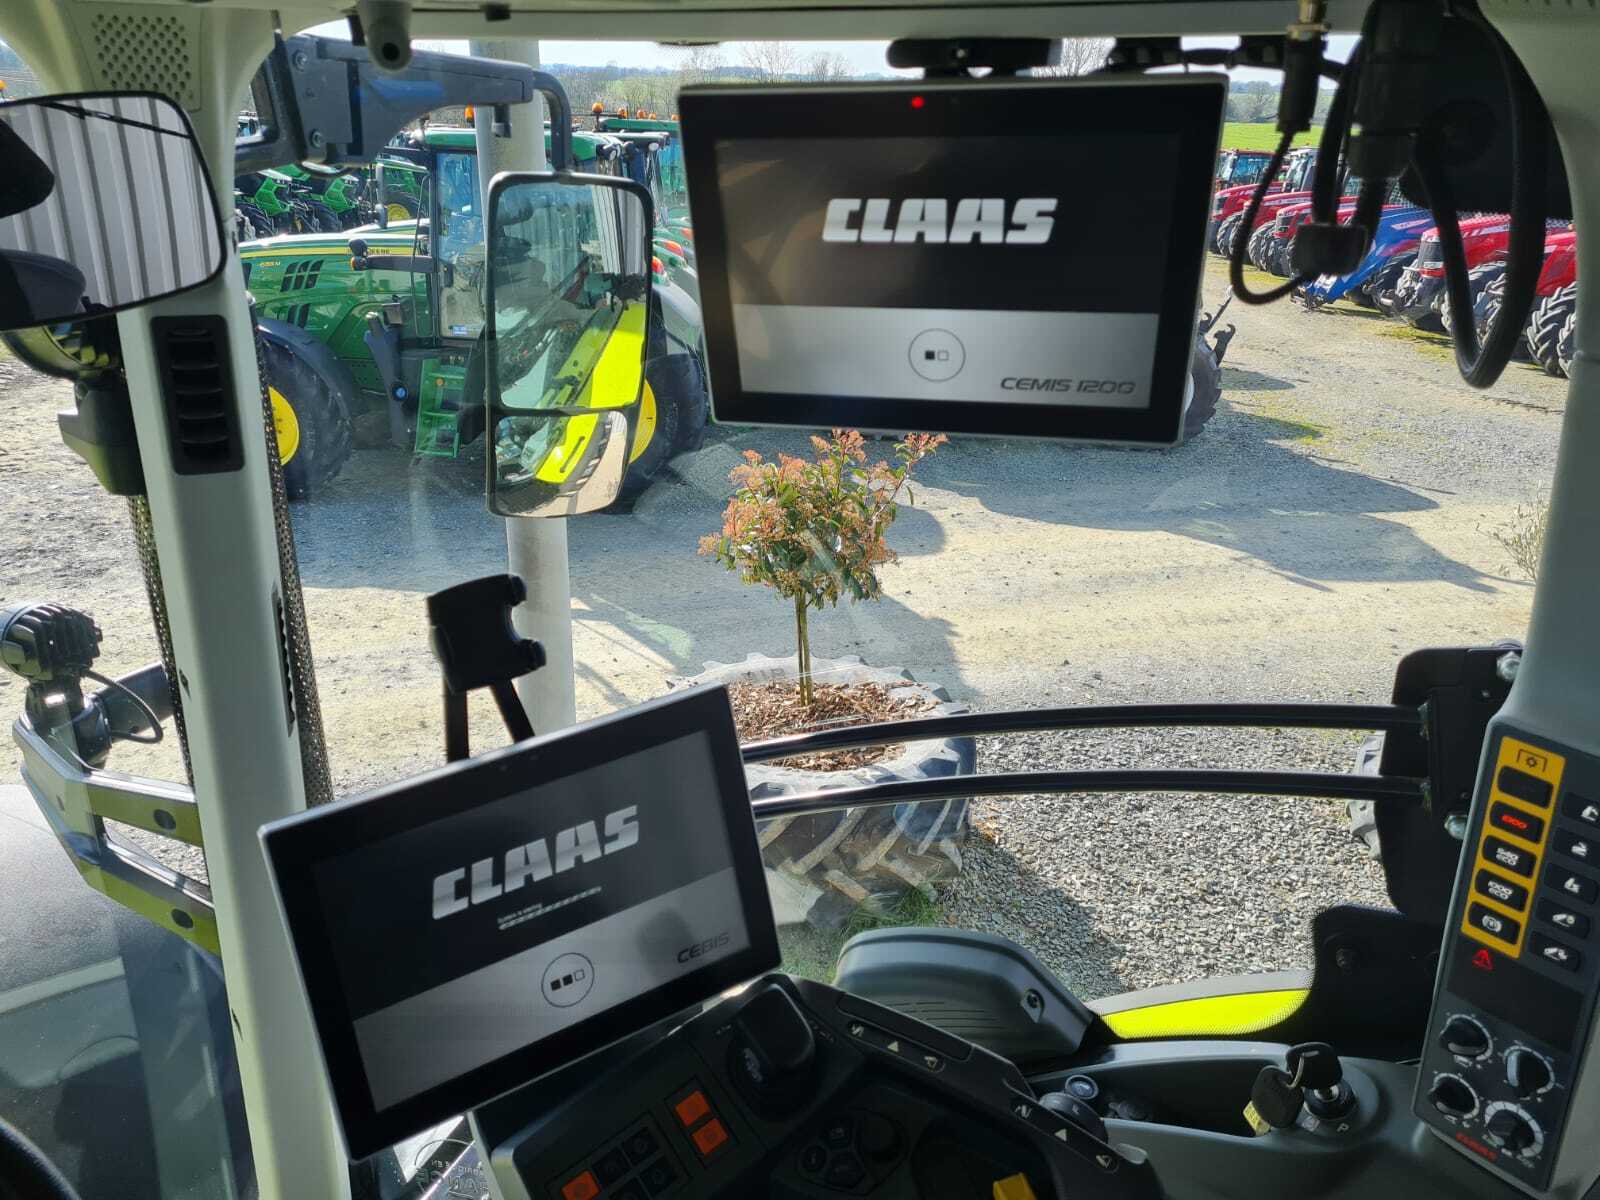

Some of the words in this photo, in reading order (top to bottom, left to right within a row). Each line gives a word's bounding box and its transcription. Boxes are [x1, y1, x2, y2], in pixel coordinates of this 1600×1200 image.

[822, 198, 1058, 245] CLAAS
[1000, 377, 1073, 393] CEMIS
[1075, 379, 1137, 395] 1200
[432, 805, 640, 920] CLAAS
[676, 932, 732, 964] CEBIS
[1336, 1122, 1350, 1133] P
